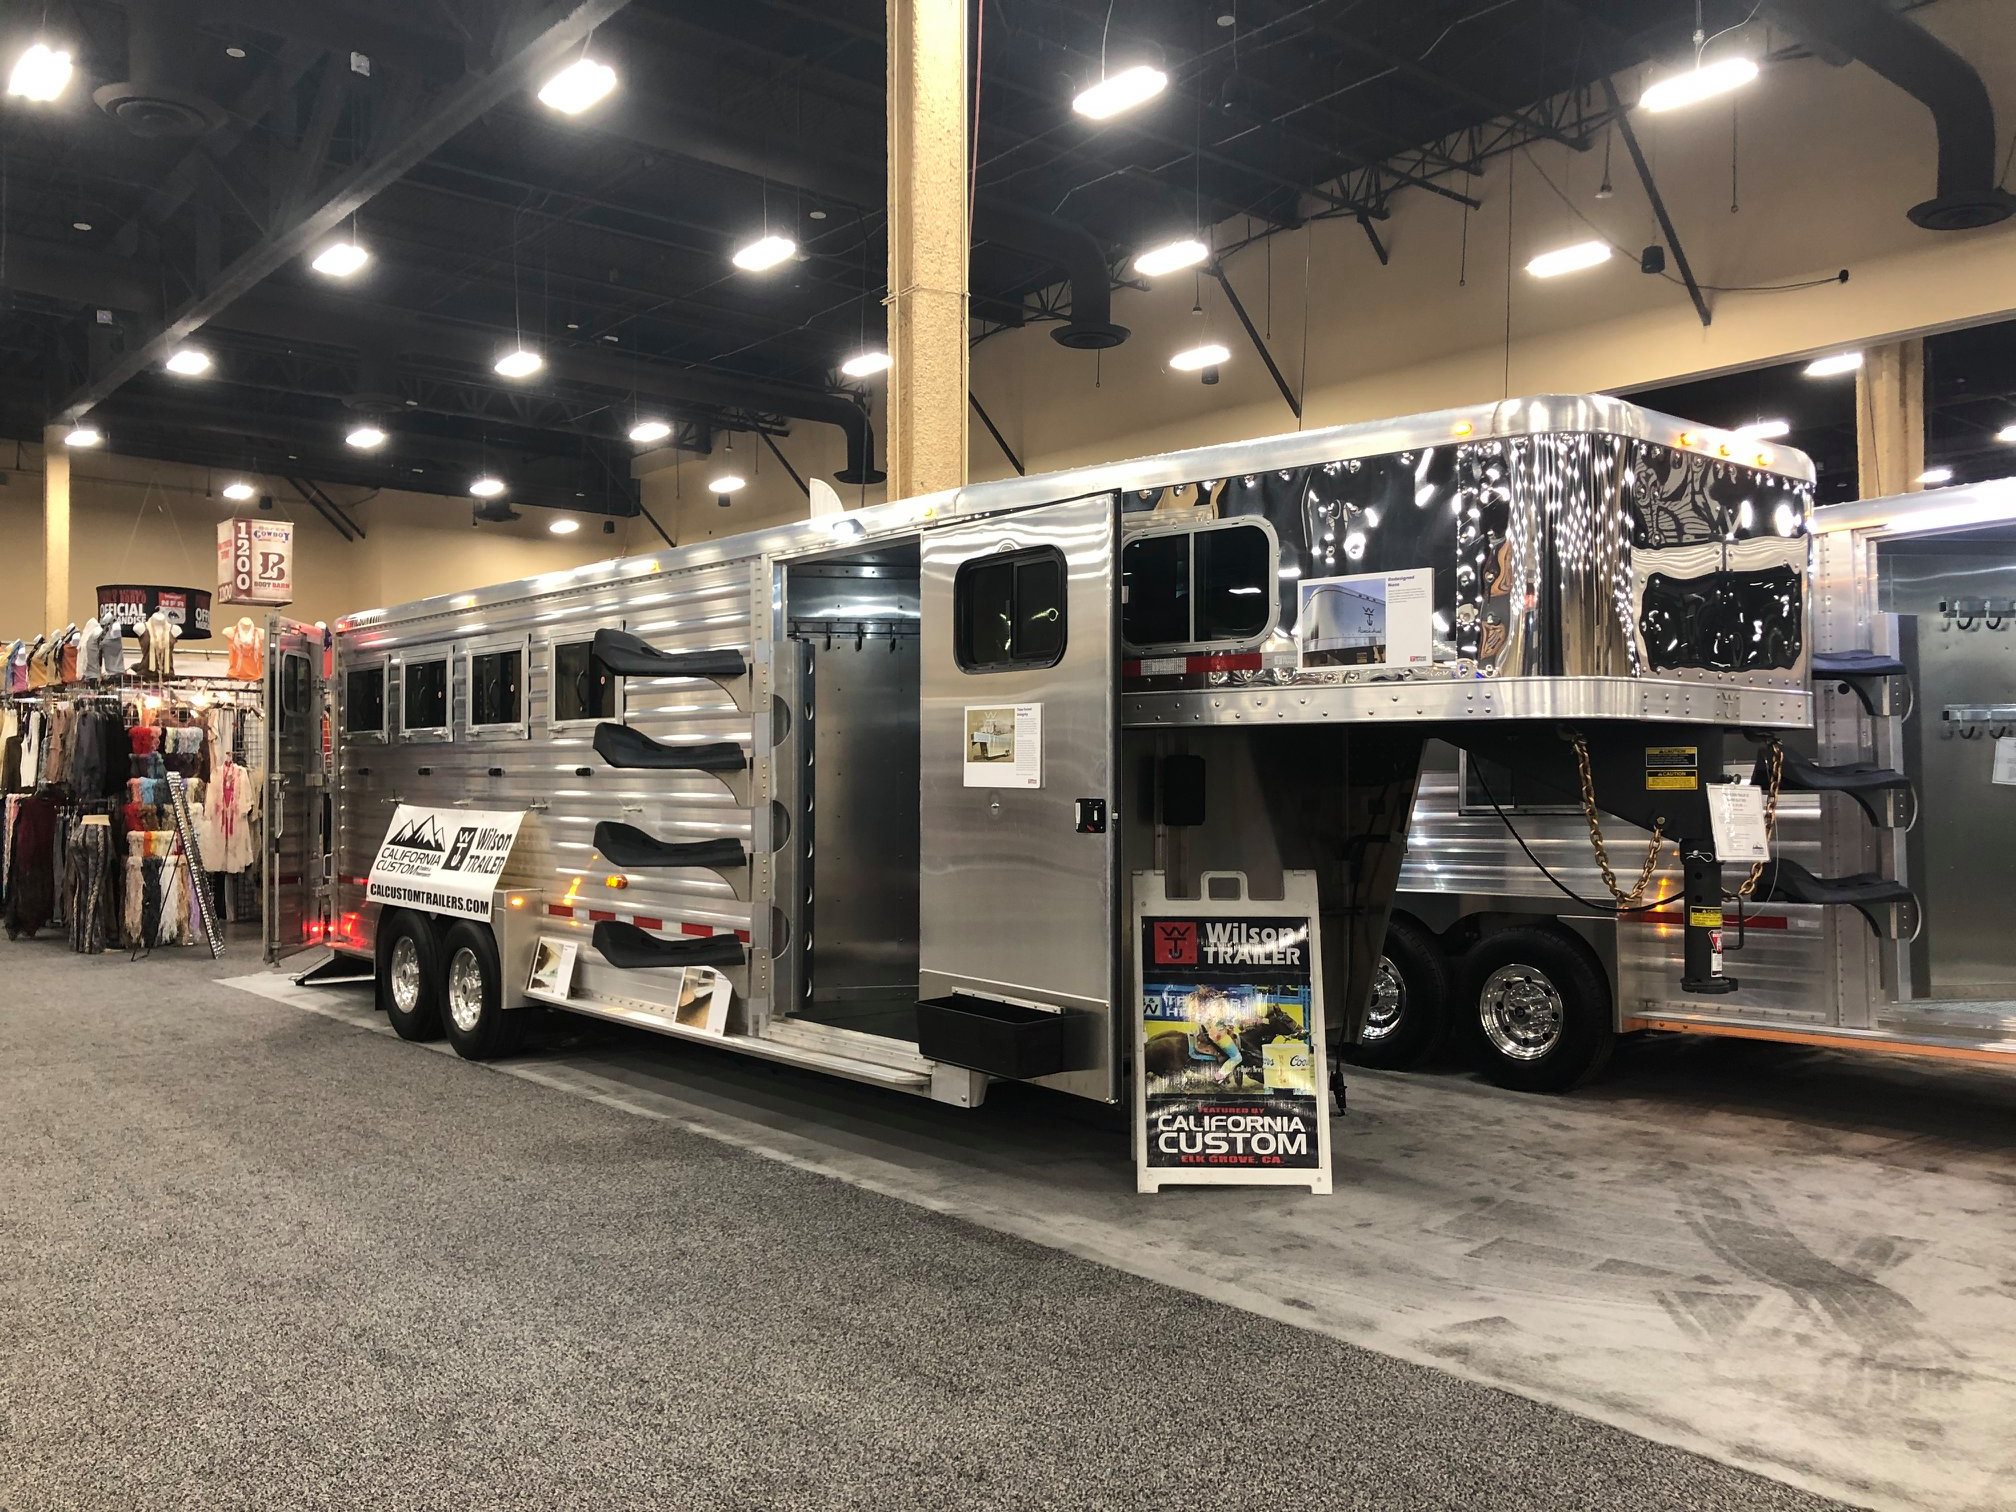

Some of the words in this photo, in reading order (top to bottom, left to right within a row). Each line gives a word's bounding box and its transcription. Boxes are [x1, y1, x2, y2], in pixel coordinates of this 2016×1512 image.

[236, 521, 251, 590] 1200
[100, 602, 147, 617] OFFICIAL
[475, 827, 513, 851] Wilson
[381, 847, 442, 867] CALIFORNIA
[463, 854, 505, 875] TRAILER
[375, 859, 419, 876] CUSTOM
[370, 883, 490, 915] CALCUSTOMTRAILERS.COM
[1205, 922, 1296, 944] Wilson
[1203, 945, 1301, 965] TRAILER
[1198, 1106, 1249, 1115] FEATURED
[1251, 1107, 1265, 1115] BY
[1158, 1115, 1306, 1133] CALIFORNIA
[1158, 1132, 1307, 1155] CUSTOM
[1180, 1155, 1205, 1164] ELK
